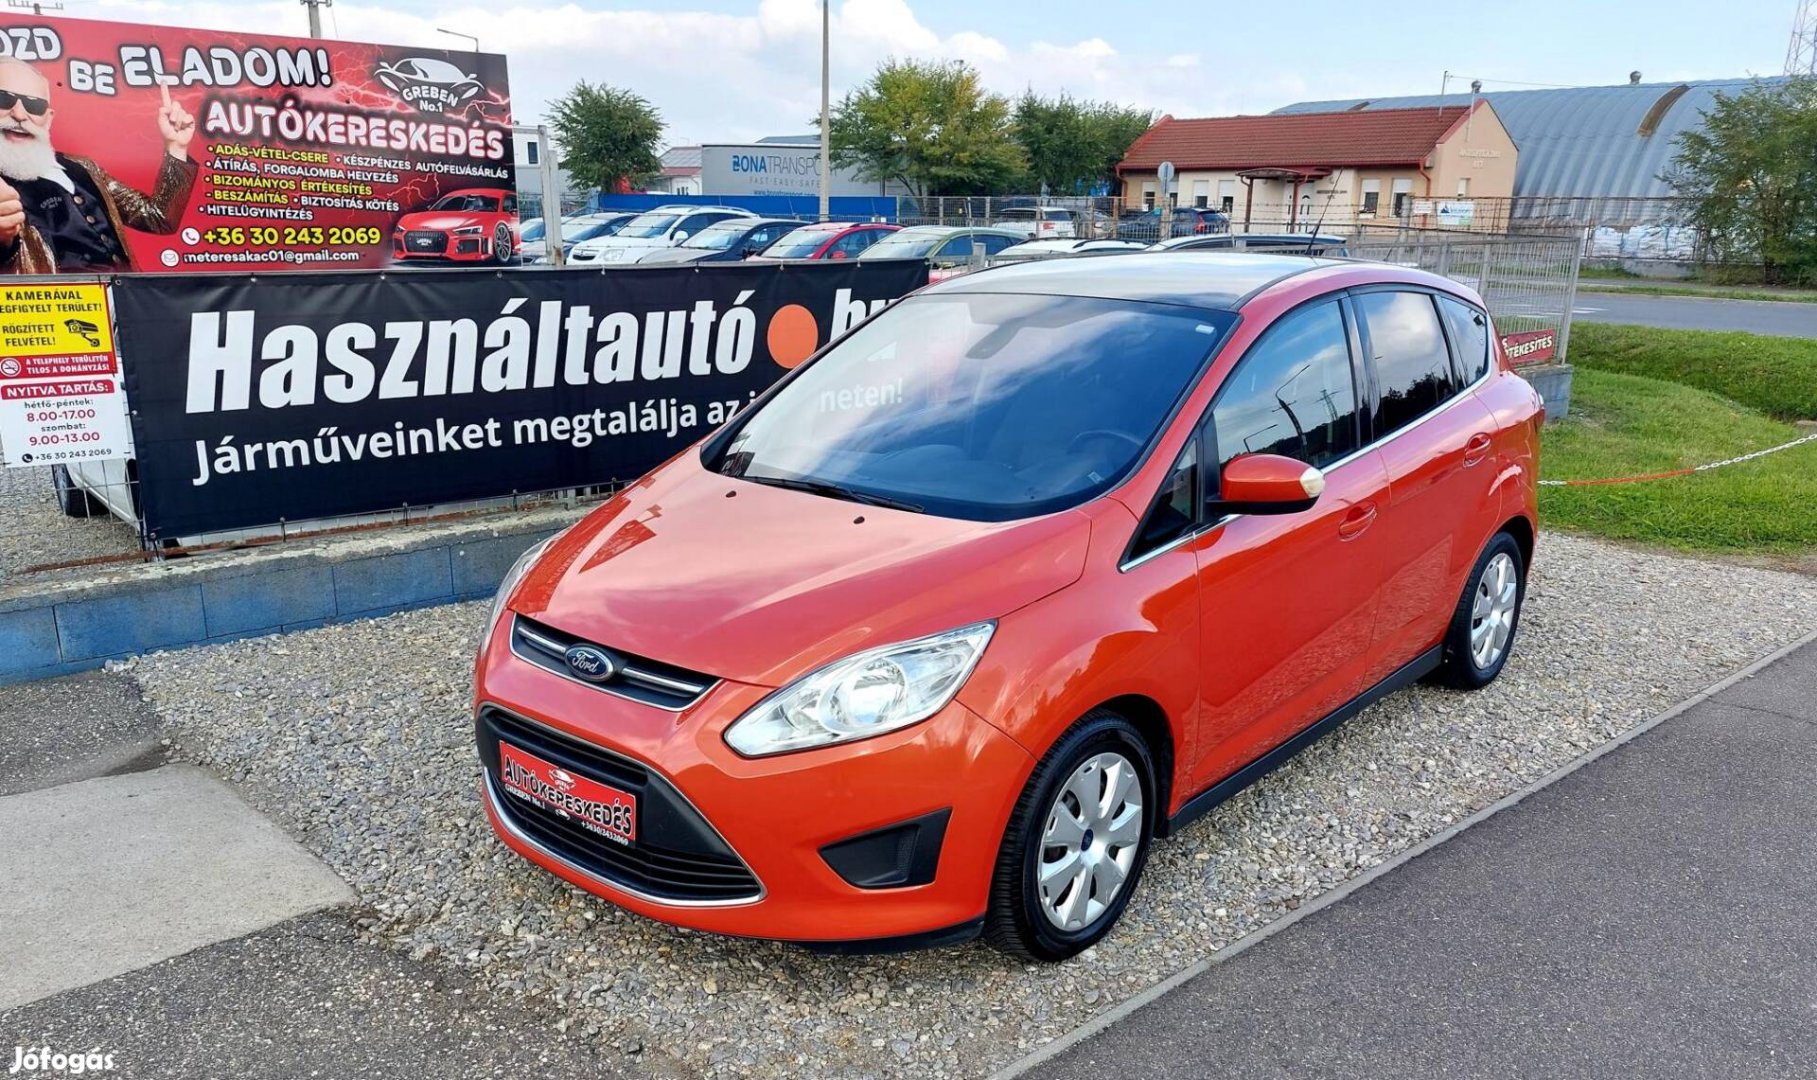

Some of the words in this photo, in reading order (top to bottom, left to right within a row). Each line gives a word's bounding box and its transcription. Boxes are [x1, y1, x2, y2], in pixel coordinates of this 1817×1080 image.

[70, 60, 116, 95] BE
[120, 47, 332, 87] ELADOM!
[402, 86, 459, 107] GREBEN
[420, 99, 443, 113] No.1
[206, 101, 505, 159] AUTÓKERESKEDÉS
[214, 158, 261, 174] ÁTÍRÁS,
[264, 164, 344, 179] FORGALOMBA
[347, 170, 399, 183] HELYEZÉS
[216, 145, 329, 163] ADÁS-VÉTEL-CSERE
[343, 155, 411, 171] KÉSZPÉNZES
[416, 161, 509, 179] AUTÓFELVÁSÁRLÁS
[213, 175, 296, 190] BIZOMÁNYOS
[301, 181, 373, 196] ÉRTÉKESÍTÉS
[214, 190, 289, 205] BESZÁMÍTÁS
[301, 195, 364, 210] BIZTOSÍTÁS
[365, 199, 400, 212] KÖTÉS
[207, 204, 314, 220] HITELÜGYINTÉZÉS
[204, 227, 245, 245] +36
[250, 227, 279, 245] 30
[284, 227, 325, 245] 243
[329, 227, 381, 245] 2069
[6, 289, 83, 301] KAMERÁVAL
[56, 302, 102, 312] TERÜLET!
[2, 322, 55, 334] RÖGZÍTETT
[5, 335, 56, 347] FELVÉTEL!
[185, 290, 757, 415] Használtautó
[27, 366, 50, 374] TILOS
[6, 385, 57, 397] NYITVA
[58, 380, 109, 394] TARTÁS:
[26, 409, 96, 422] 8.00-17.00
[41, 423, 87, 432] szombat:
[29, 432, 100, 446] 9.00-13.00
[192, 418, 502, 487] Járműveinket
[513, 398, 698, 448] megtalálja
[707, 399, 740, 425] az
[69, 450, 87, 458] 243
[88, 448, 112, 457] 2069
[572, 651, 600, 673] Ford
[504, 754, 633, 837] AUTÓKERESKEDÉS
